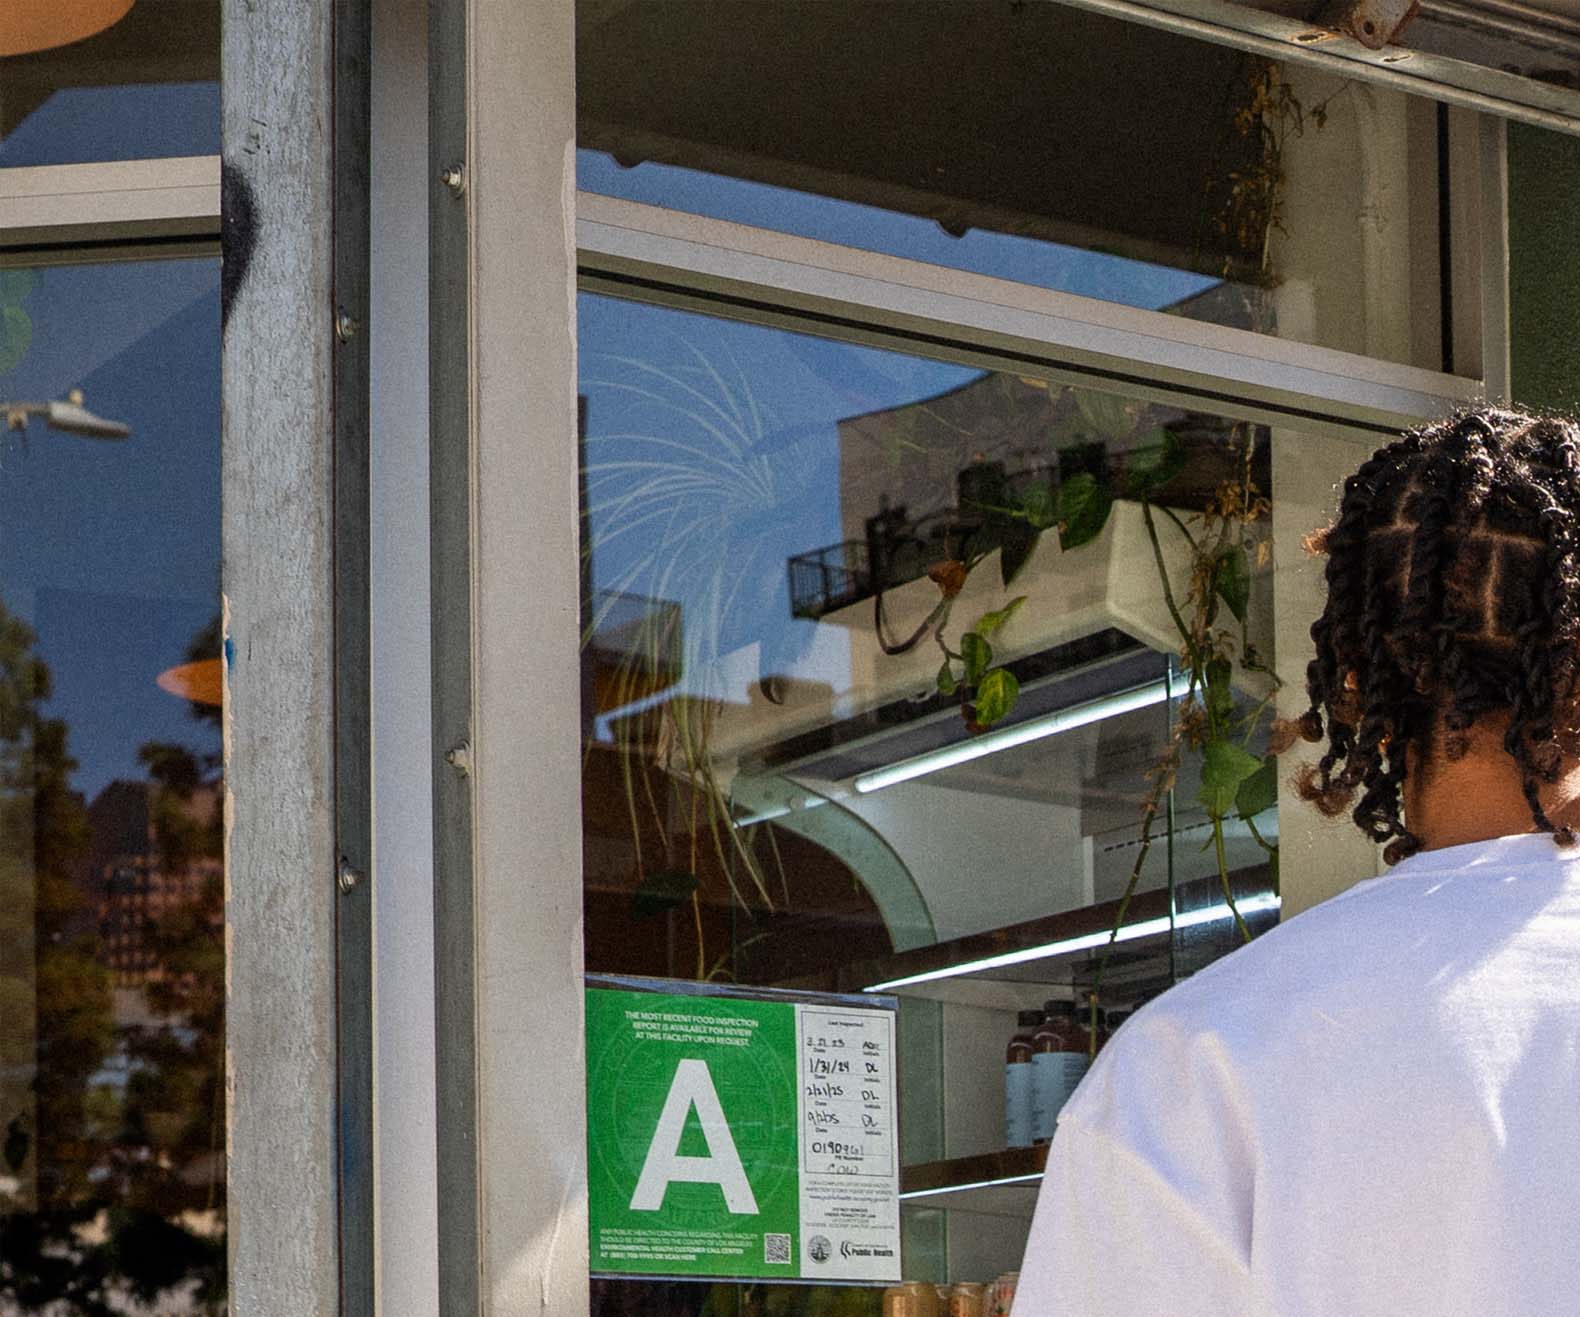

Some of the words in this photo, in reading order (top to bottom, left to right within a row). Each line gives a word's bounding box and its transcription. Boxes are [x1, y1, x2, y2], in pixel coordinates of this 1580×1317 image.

[624, 1010, 640, 1019] THE
[641, 1012, 662, 1021] MOST
[663, 1013, 693, 1023] RECENT
[694, 1015, 714, 1025] FOOD
[716, 1017, 759, 1028] INSPECTION
[633, 1021, 660, 1031] REPORT
[670, 1024, 708, 1034] AVAILABLE
[709, 1026, 724, 1035] FOR
[725, 1027, 752, 1037] REVIEW
[635, 1031, 645, 1040] AT
[646, 1032, 661, 1041] THIS
[662, 1032, 693, 1043] FACILITY
[694, 1036, 715, 1044] UPON
[809, 1057, 850, 1074] 1/31/24
[629, 1059, 760, 1214] A
[852, 1247, 872, 1257] Public
[873, 1248, 894, 1257] Health
